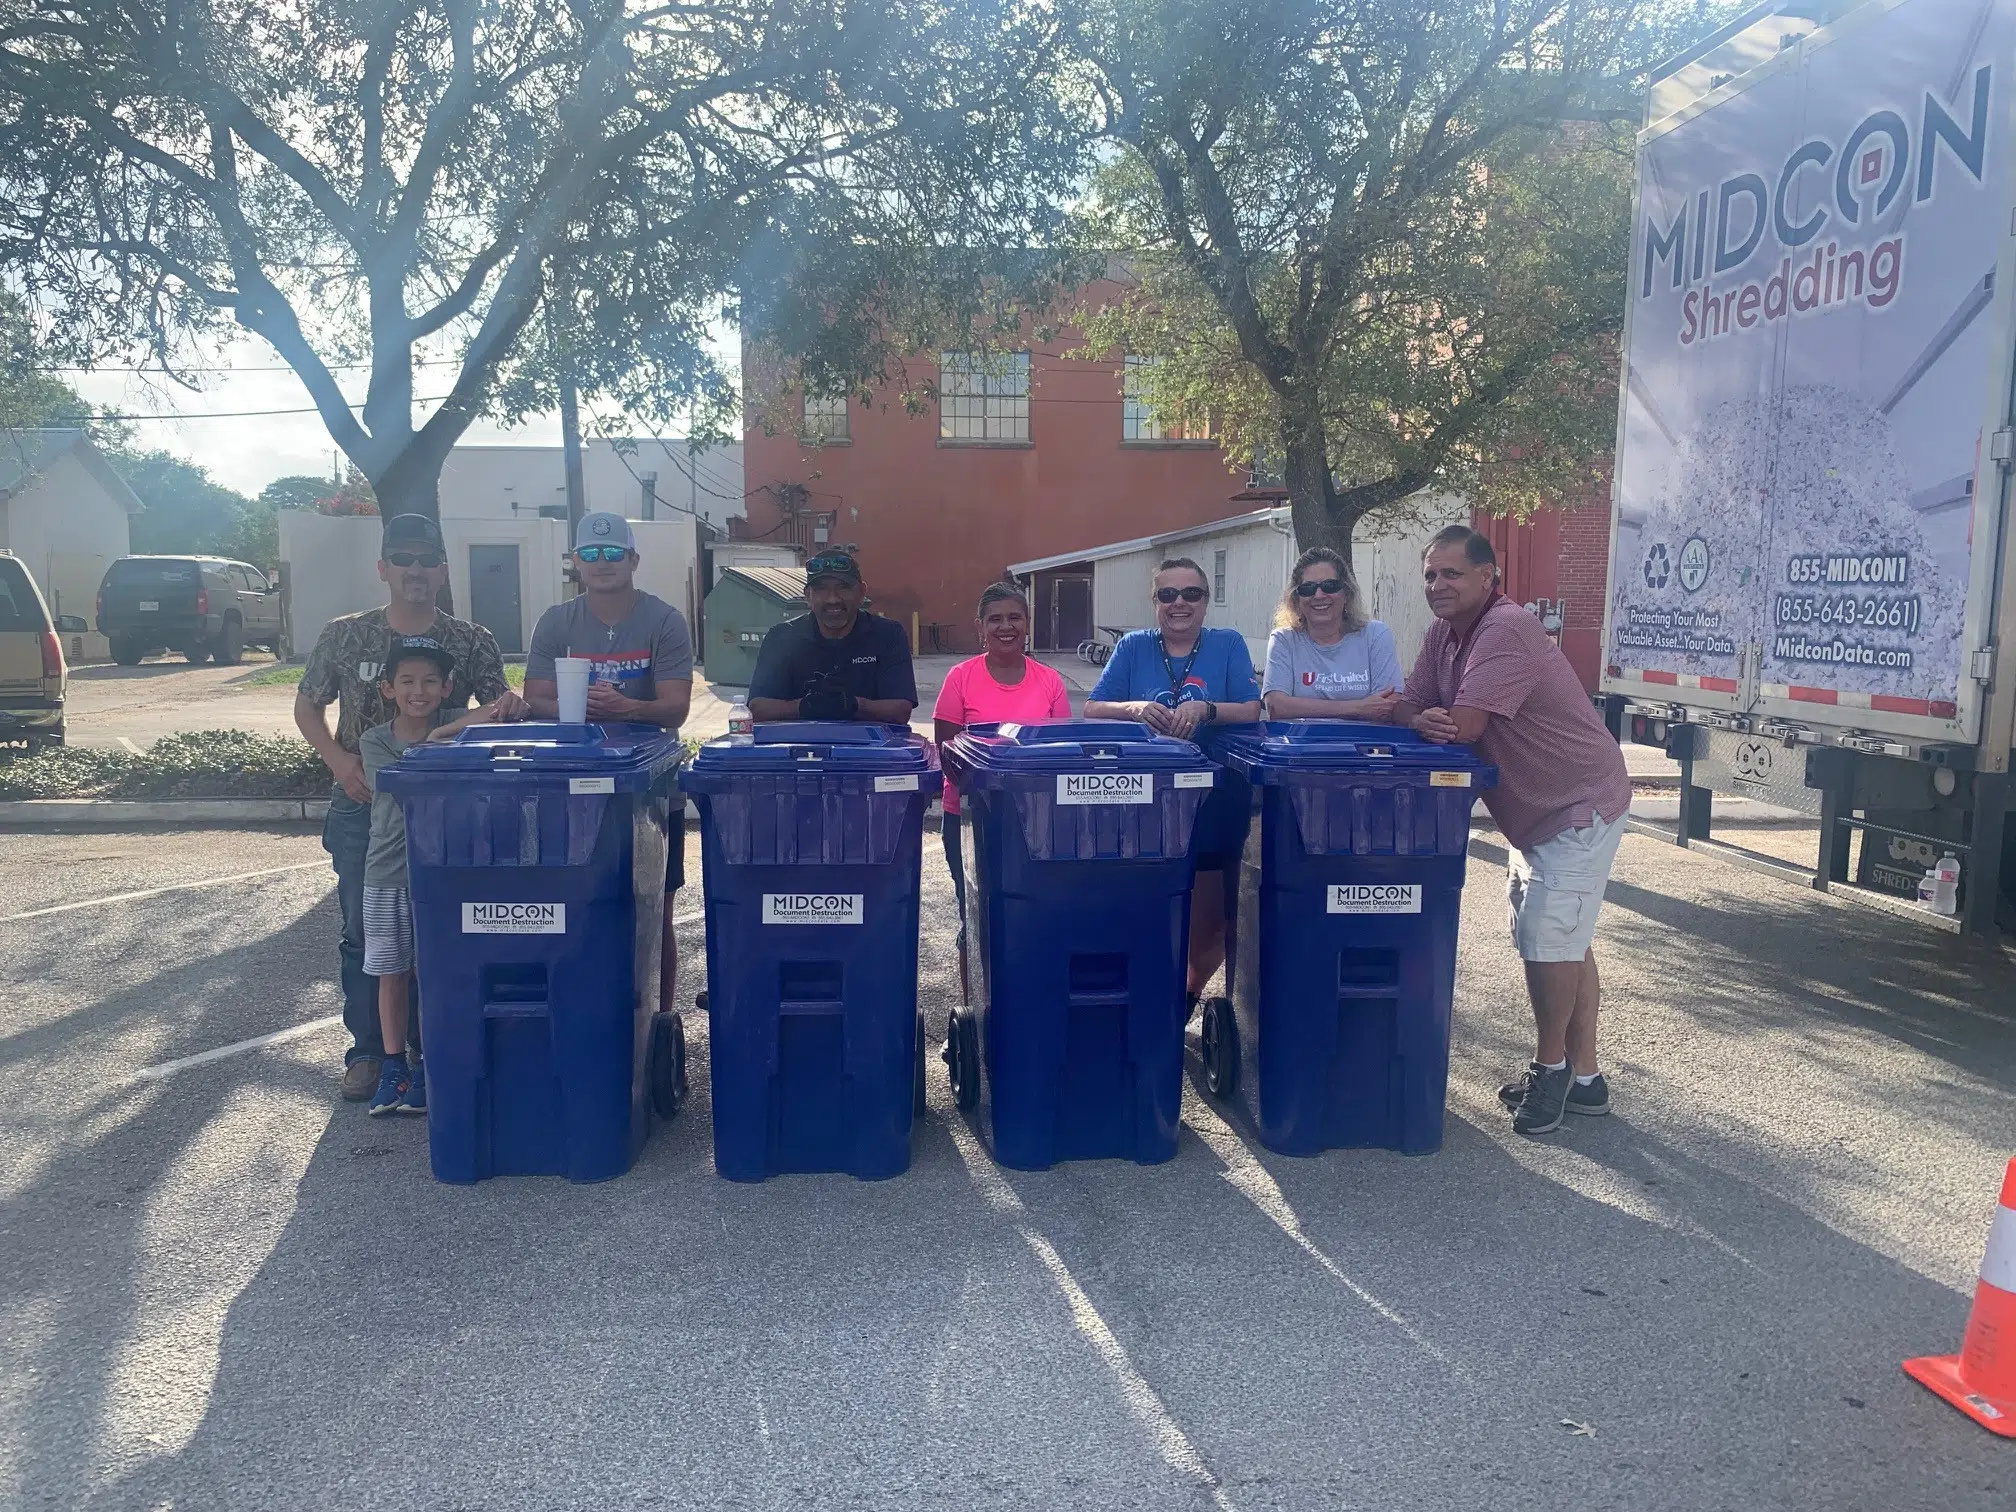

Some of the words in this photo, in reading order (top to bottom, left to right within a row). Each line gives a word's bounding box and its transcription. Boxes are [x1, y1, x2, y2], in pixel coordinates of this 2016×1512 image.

[1643, 65, 1991, 298] MIDCON
[1680, 238, 1902, 345] Shredding
[1789, 557, 1907, 582] 855-MIDCON1
[1630, 609, 1671, 629] Protecting
[1673, 611, 1694, 627] Your
[1695, 612, 1719, 628] Most
[1776, 596, 1918, 632] (855-643-2661)
[1618, 630, 1653, 646] Valuable
[1707, 637, 1734, 654] Data.
[1775, 637, 1911, 667] MidconData.com
[1067, 775, 1143, 790] MIDCON
[773, 895, 853, 910] MIDCON
[1337, 886, 1412, 900] MIDCON
[473, 904, 554, 919] MIDCON
[511, 918, 555, 926] Destruction
